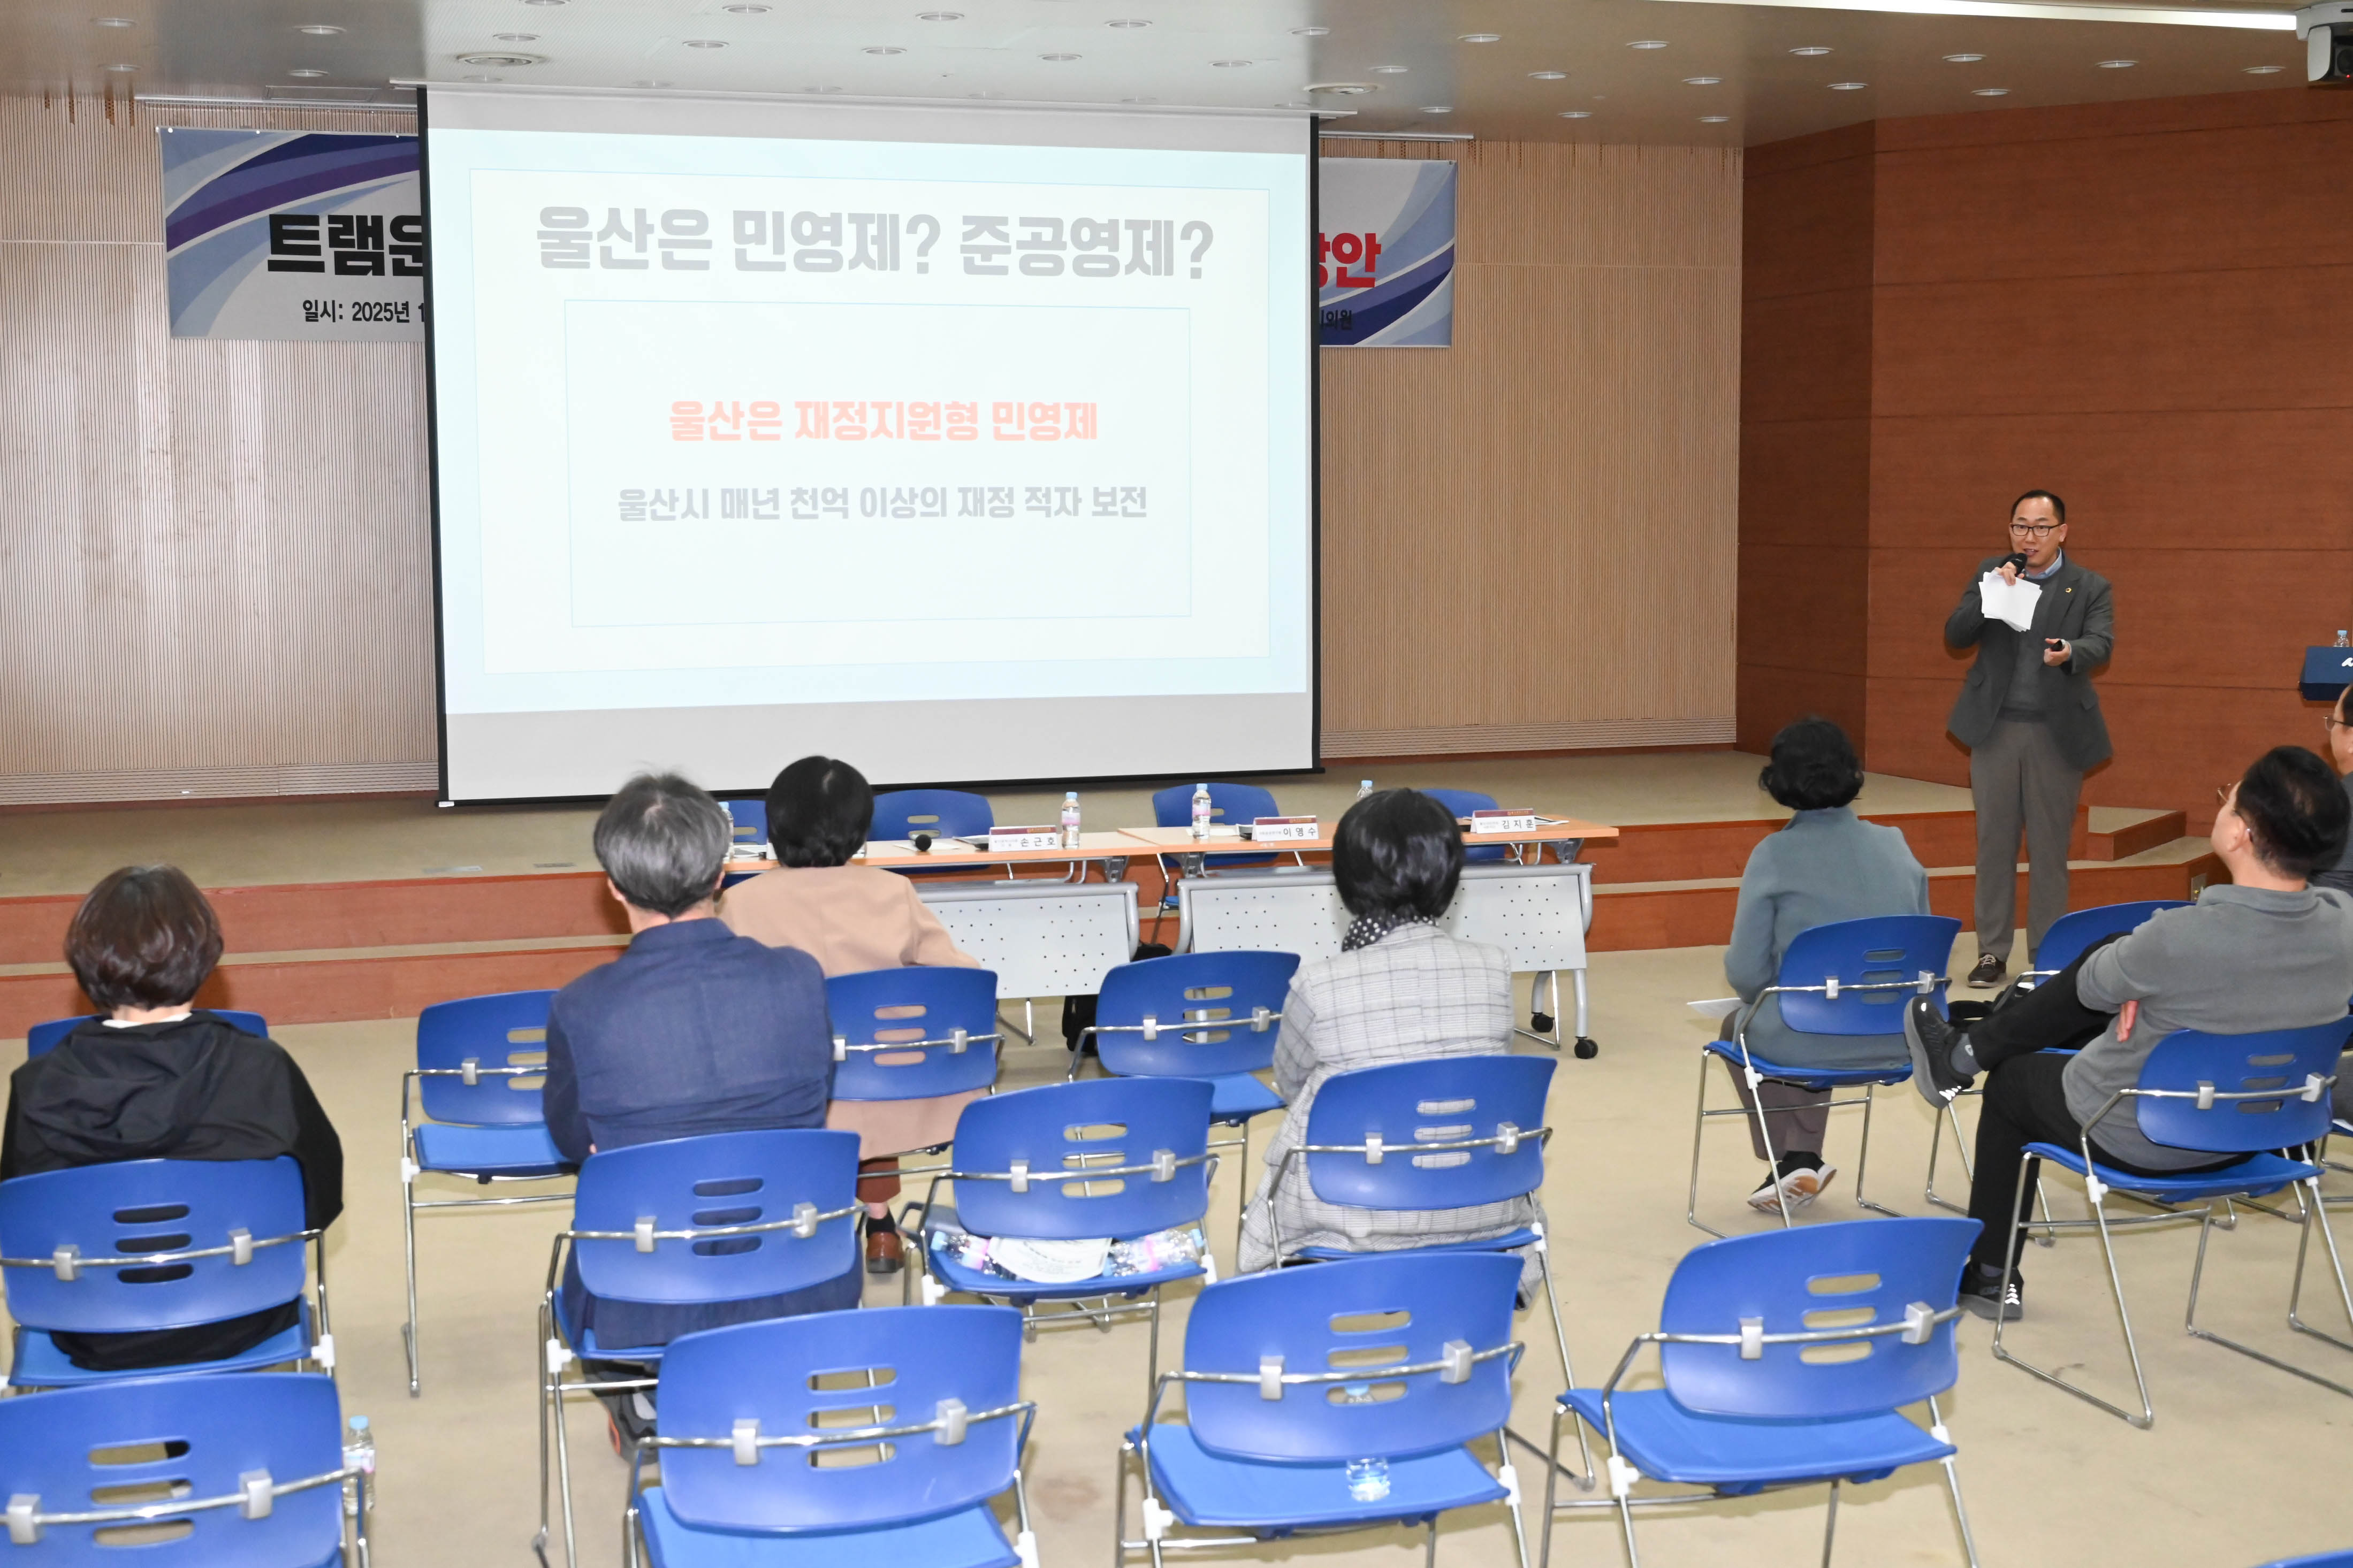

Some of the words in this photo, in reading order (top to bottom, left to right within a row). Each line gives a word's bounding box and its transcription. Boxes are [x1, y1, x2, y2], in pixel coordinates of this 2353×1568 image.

[537, 207, 712, 270] 울산은
[733, 210, 940, 274] 민영제?
[961, 216, 1213, 279] 준공영제?
[303, 300, 342, 322] 일시:
[352, 301, 409, 323] 2025년
[1321, 309, 1352, 330] 의원
[669, 401, 782, 441] 울산은
[795, 401, 978, 441] 재정지원형
[993, 402, 1098, 441] 민영제
[619, 489, 708, 521] 울산시
[721, 488, 779, 519] 매년
[791, 487, 848, 519] 천억
[861, 487, 946, 518] 이상의
[958, 487, 1014, 518] 재정
[1025, 487, 1082, 517] 적자
[1092, 487, 1146, 517] 보전
